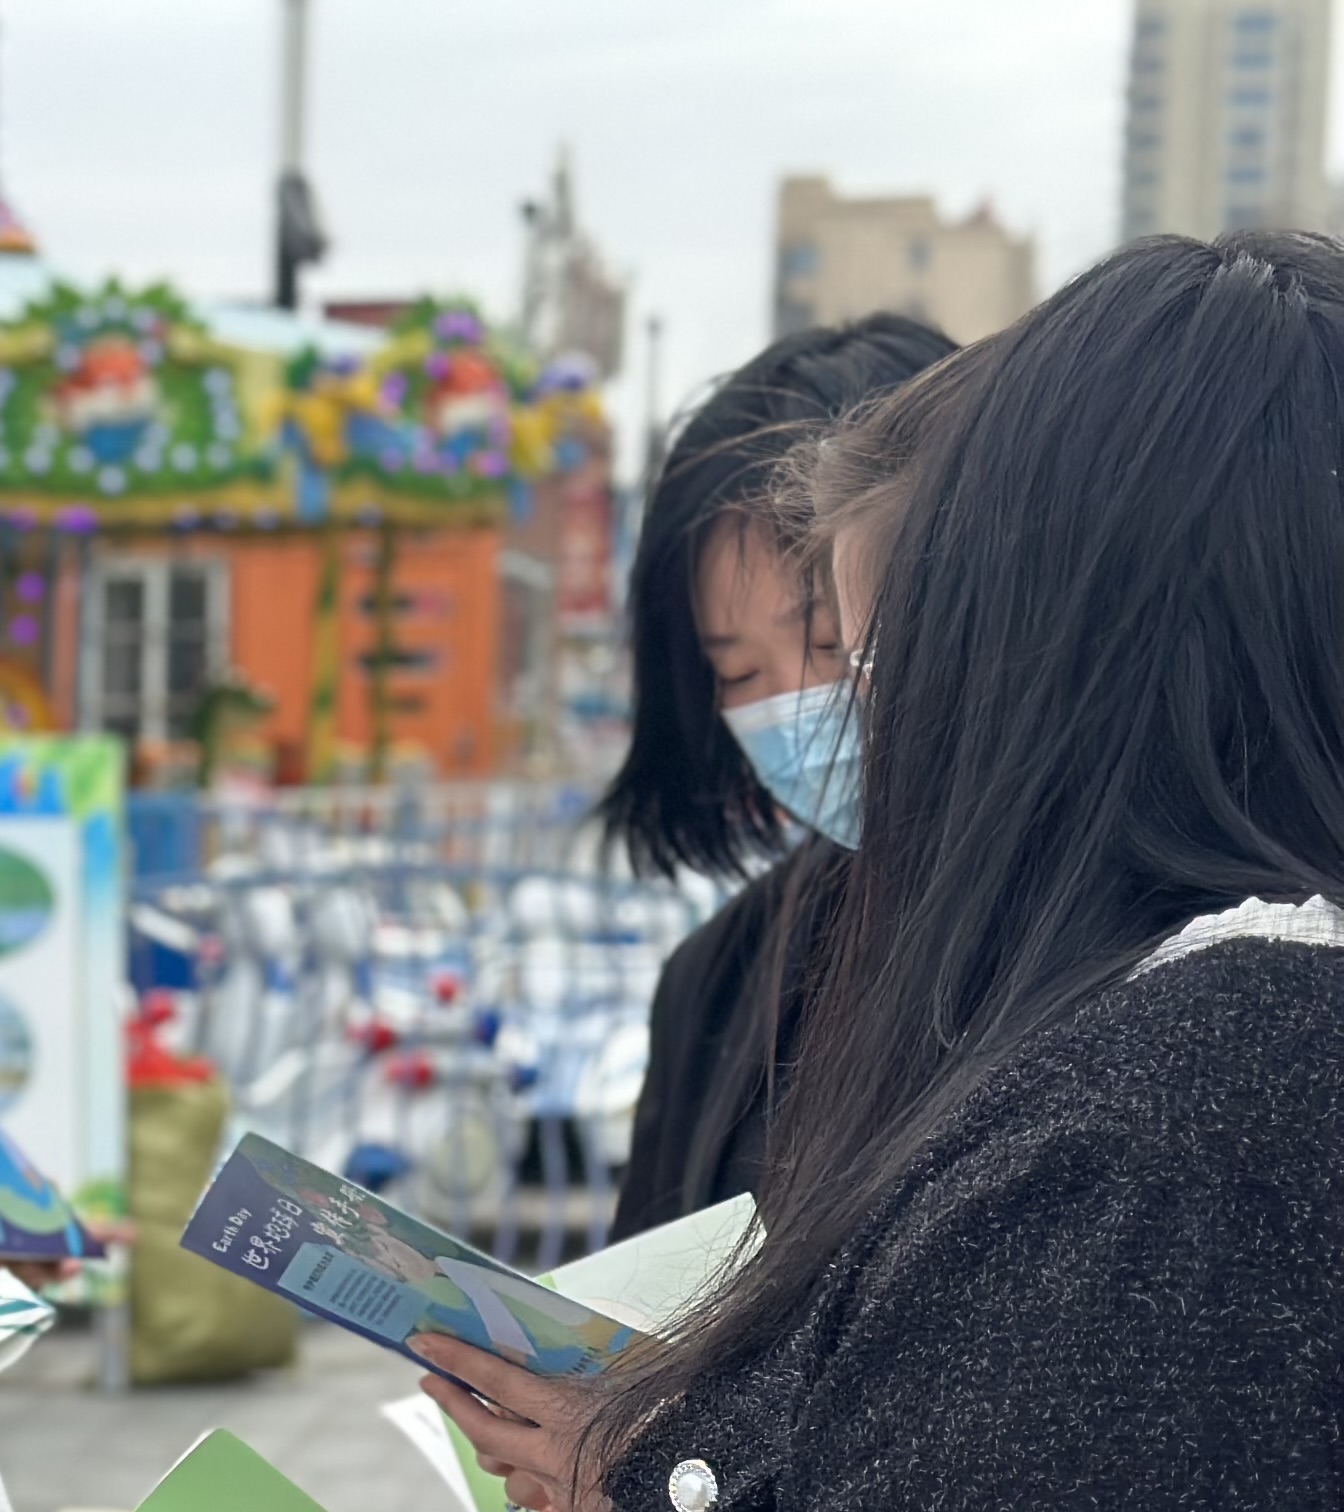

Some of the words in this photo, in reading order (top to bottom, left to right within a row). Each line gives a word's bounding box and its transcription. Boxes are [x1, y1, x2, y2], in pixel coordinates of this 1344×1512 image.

[212, 1220, 239, 1253] Earth
[229, 1206, 253, 1229] Day
[240, 1197, 303, 1271] 世界地球日
